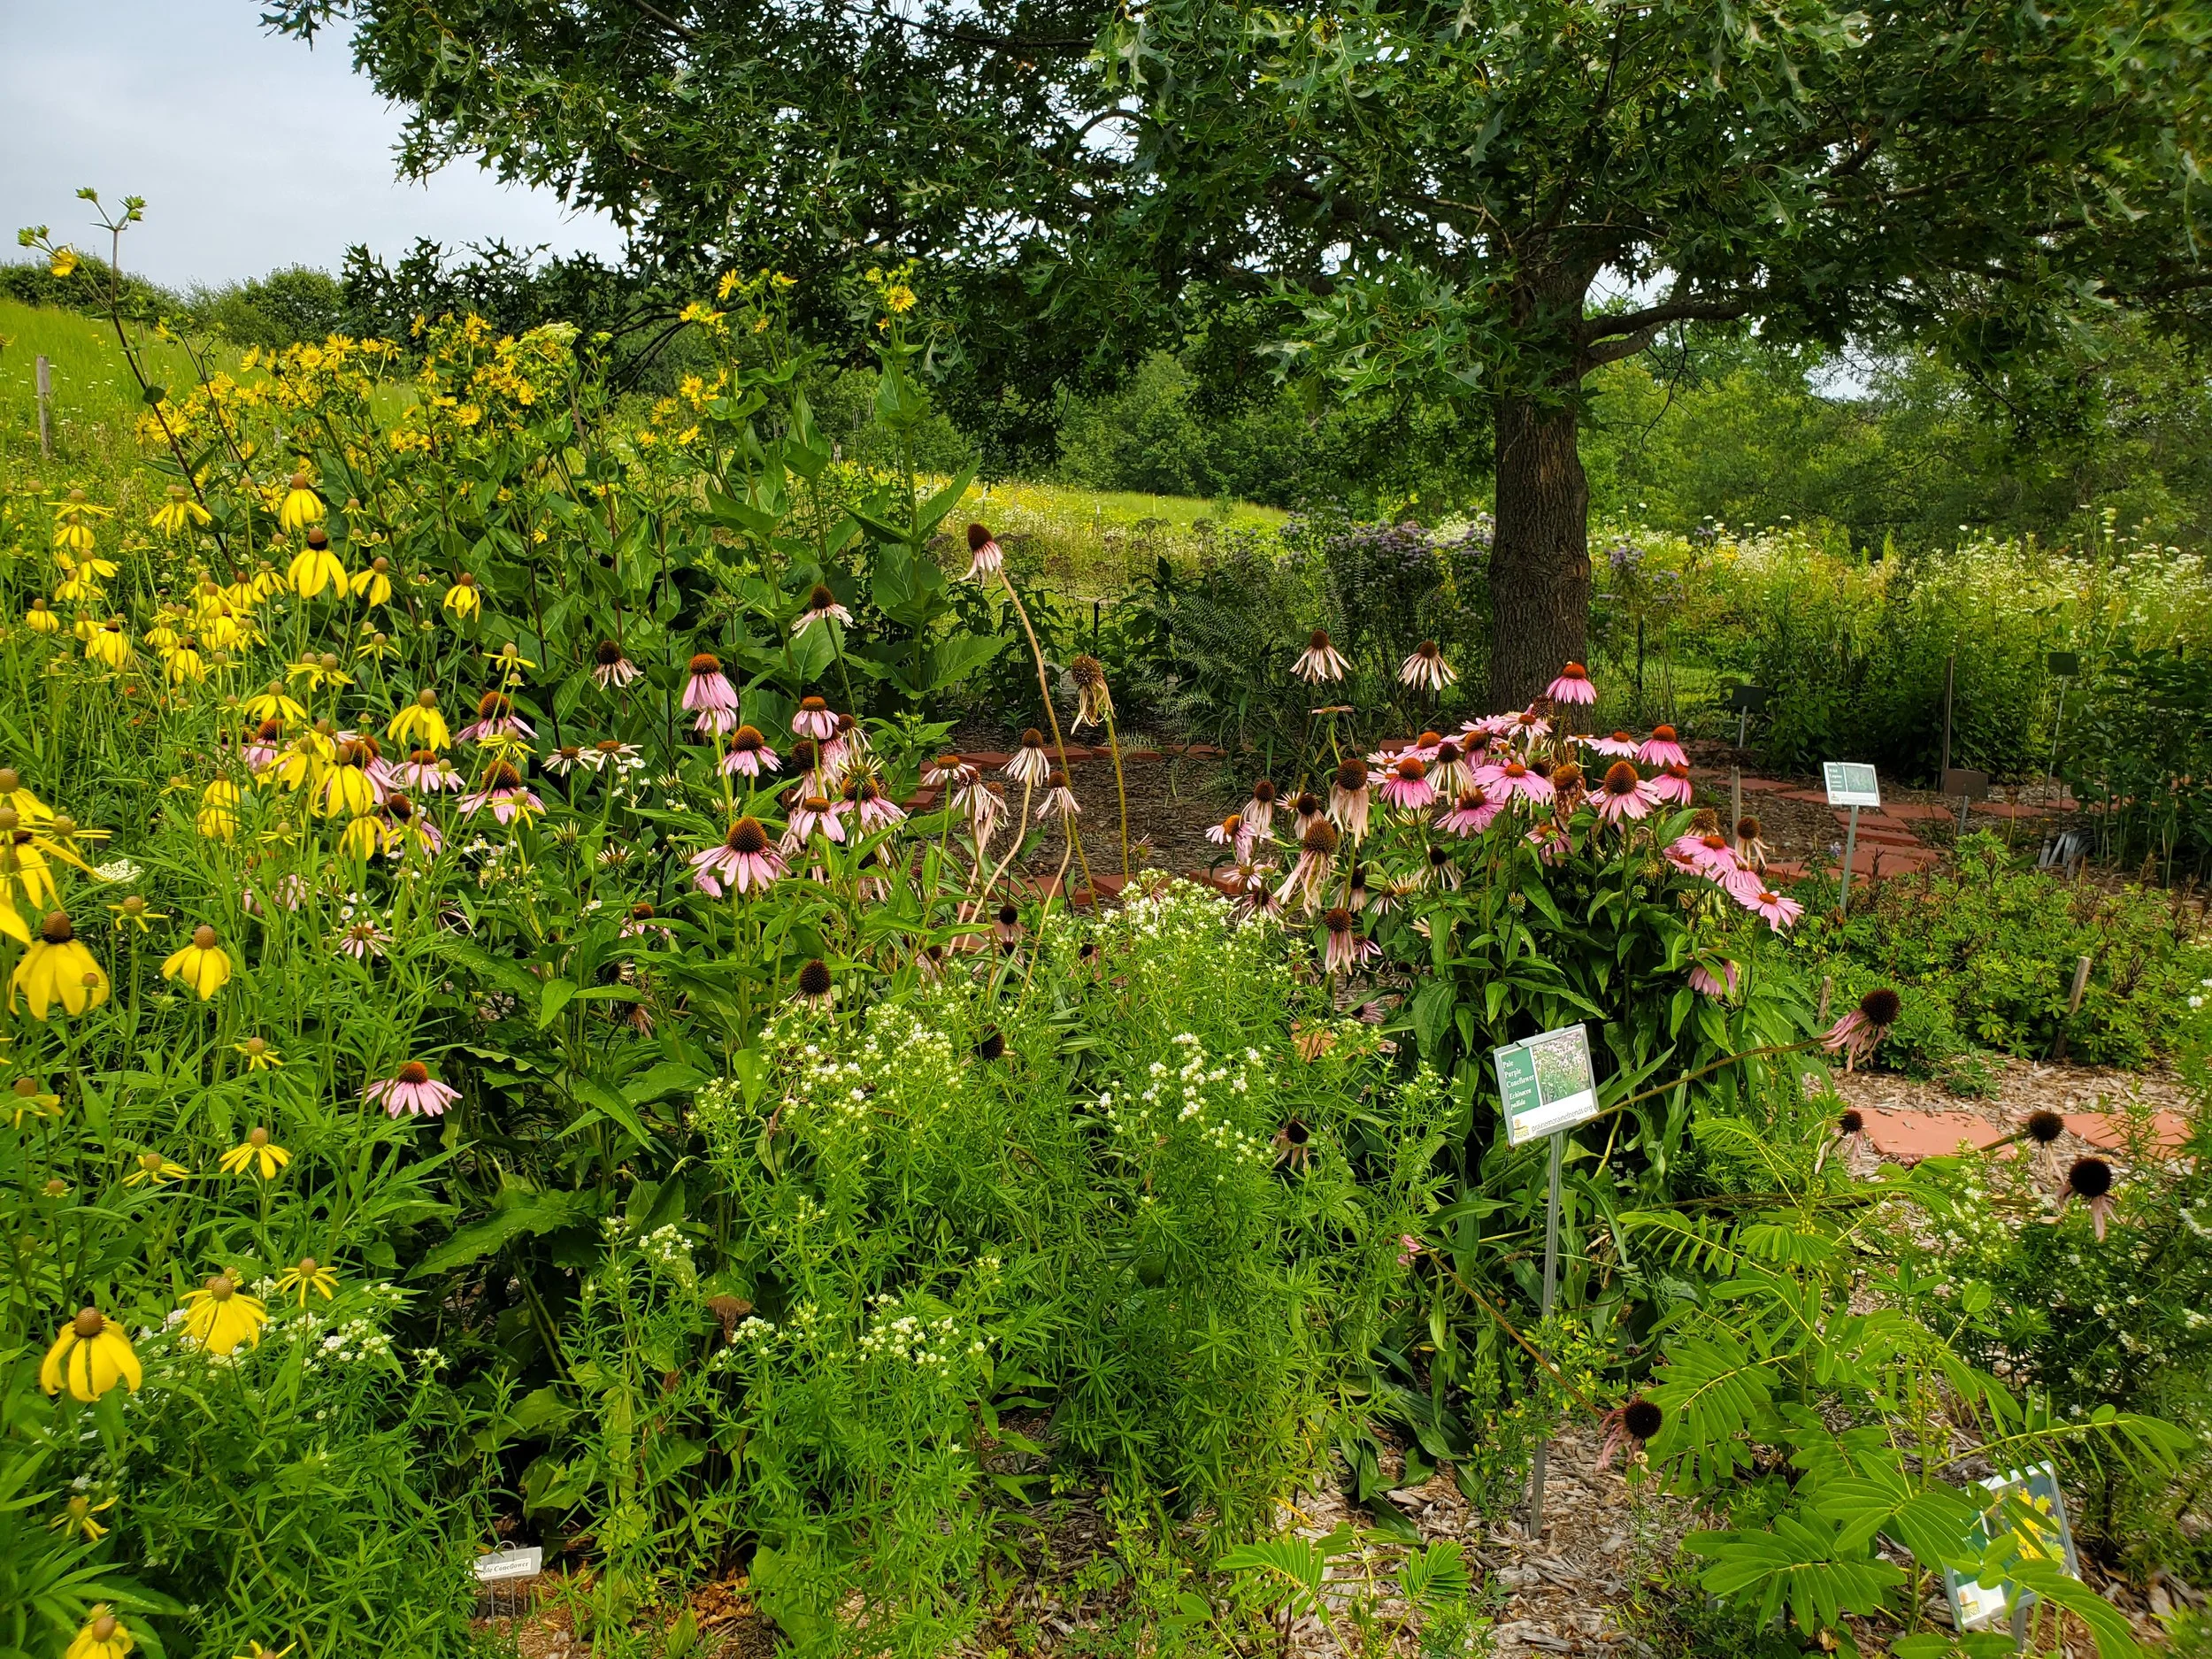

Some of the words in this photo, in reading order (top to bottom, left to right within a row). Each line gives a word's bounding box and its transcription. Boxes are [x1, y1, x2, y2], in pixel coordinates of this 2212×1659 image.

[1504, 1068, 1522, 1079] Purple
[1506, 1074, 1535, 1088] Coneflower
[494, 1562, 529, 1572] Coneflower
